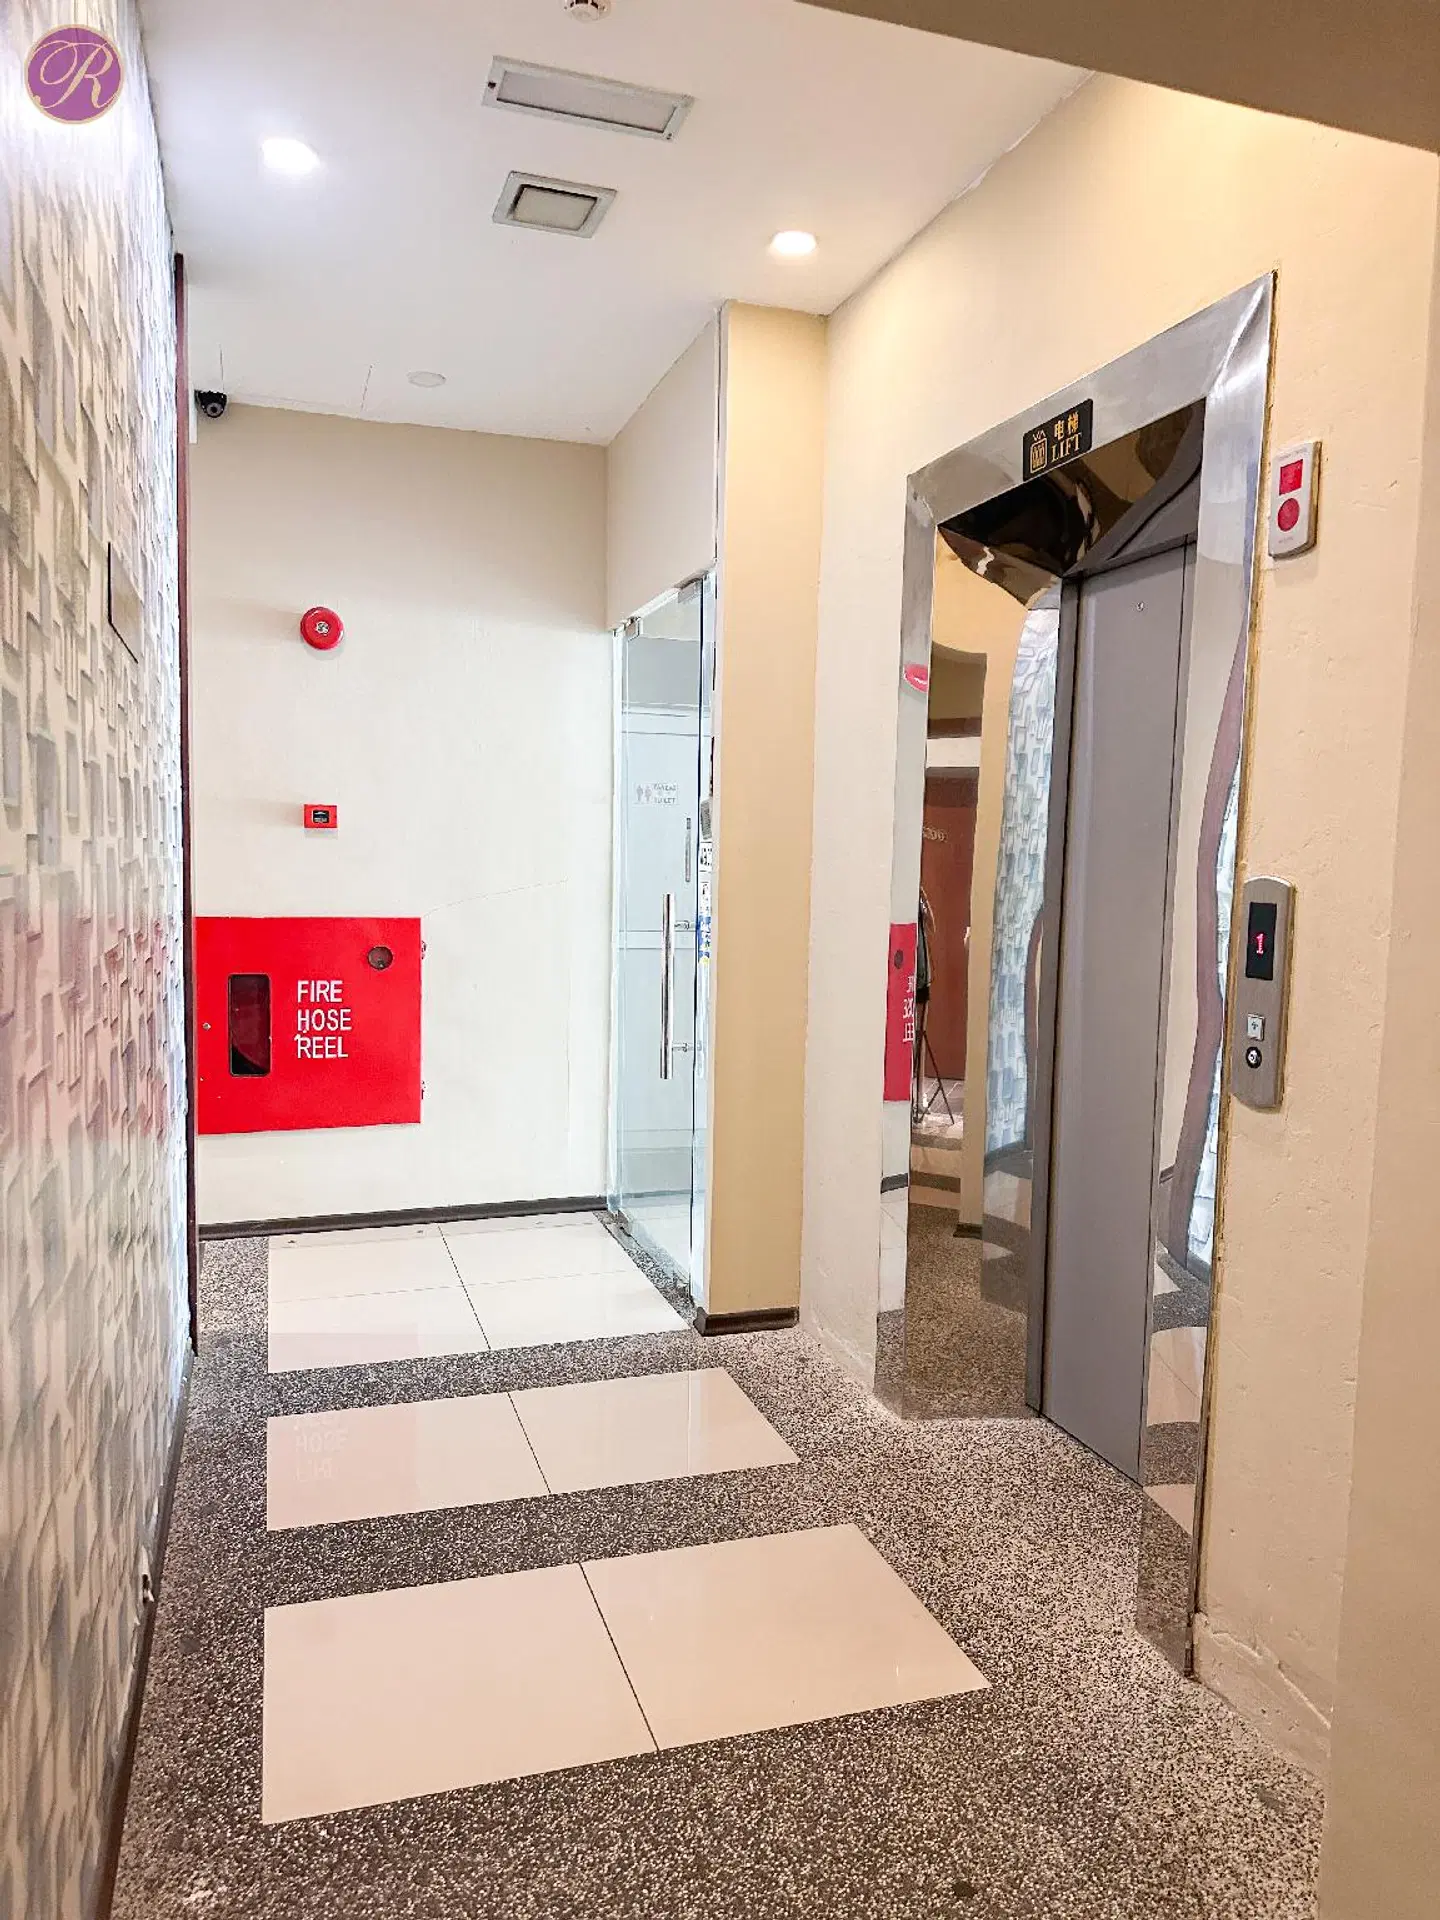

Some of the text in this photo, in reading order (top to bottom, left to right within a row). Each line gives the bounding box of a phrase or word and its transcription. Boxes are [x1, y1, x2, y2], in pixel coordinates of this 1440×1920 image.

[1051, 432, 1082, 463] LIFT
[1255, 933, 1264, 955] 1
[297, 980, 343, 1003] FIRE
[297, 1009, 352, 1031] HOSE
[296, 1036, 349, 1059] REEL
